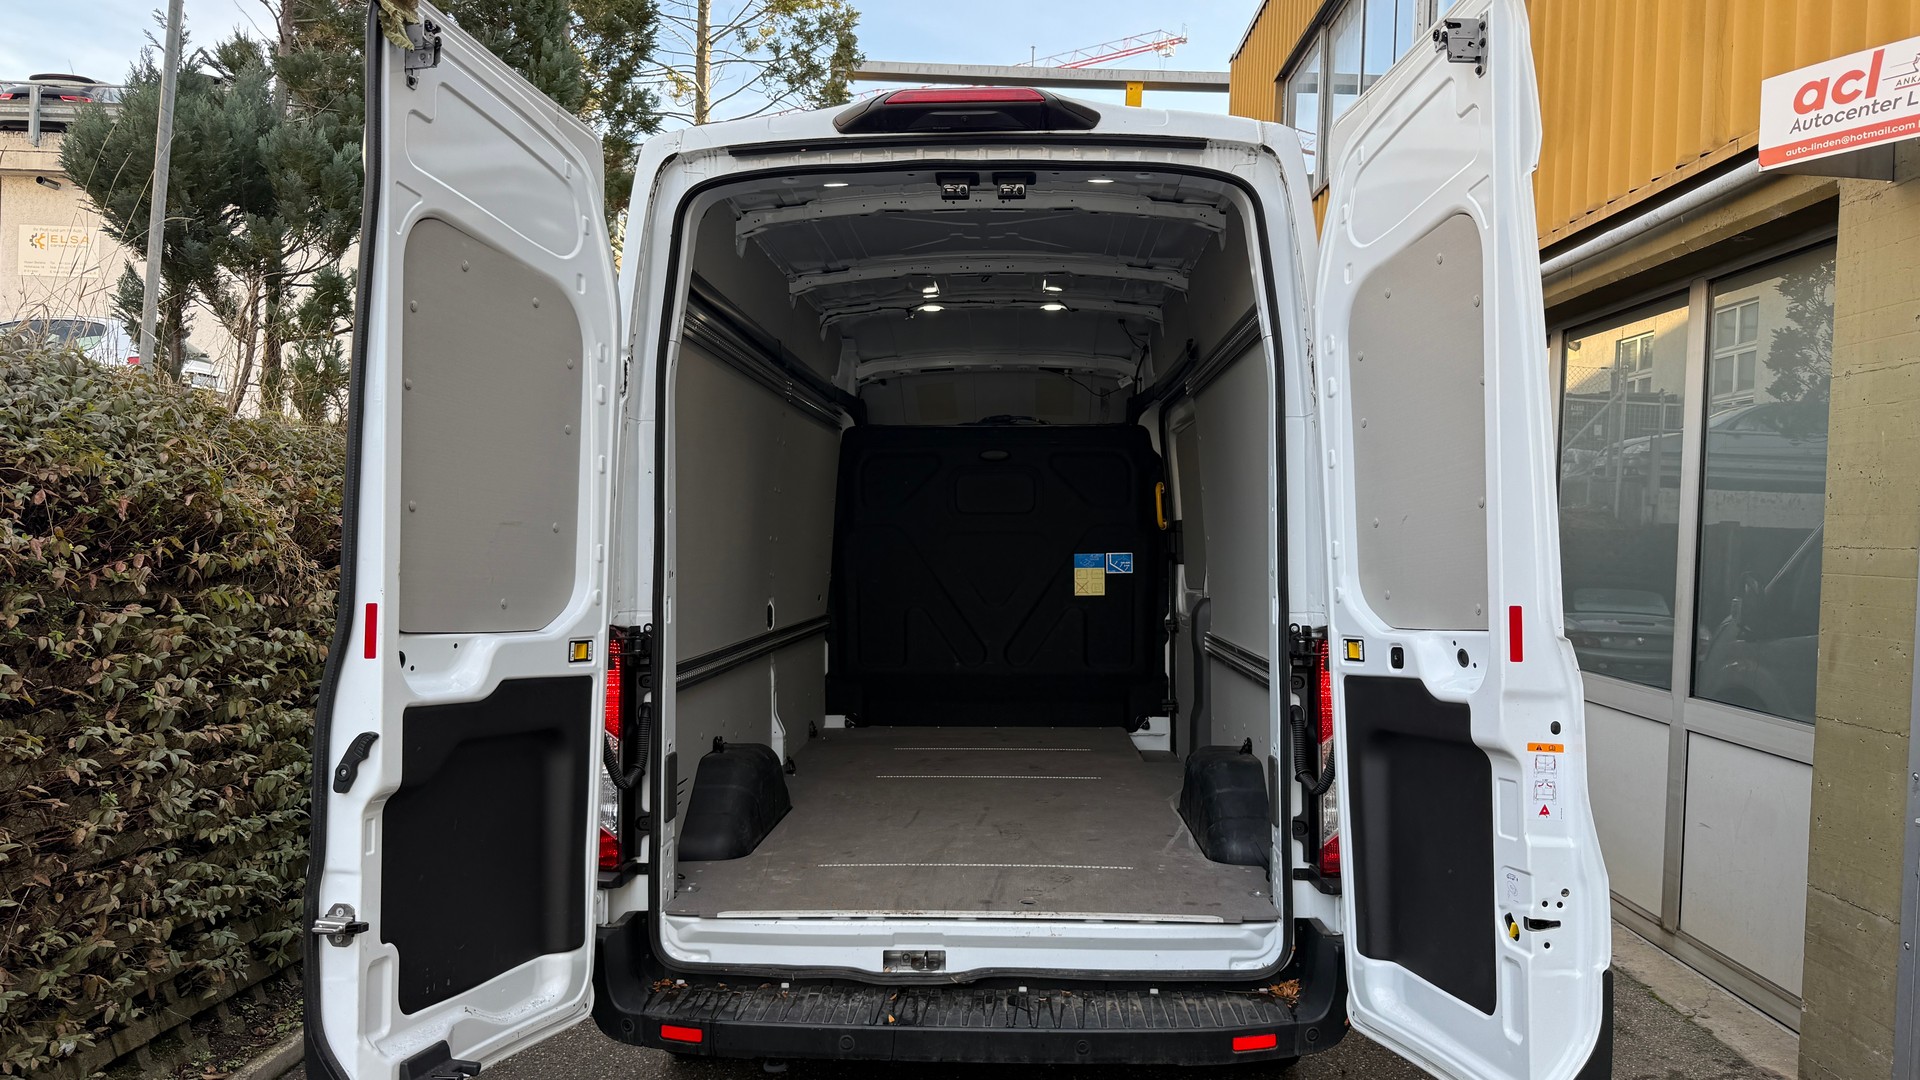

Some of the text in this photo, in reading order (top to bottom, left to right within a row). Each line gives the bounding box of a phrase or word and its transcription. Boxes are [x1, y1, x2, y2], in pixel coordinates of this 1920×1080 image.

[1793, 49, 1885, 115] acl
[1789, 96, 1902, 135] Autocenter
[1786, 121, 1916, 157] auto-linden@hotmail.com
[50, 235, 89, 244] ELSA
